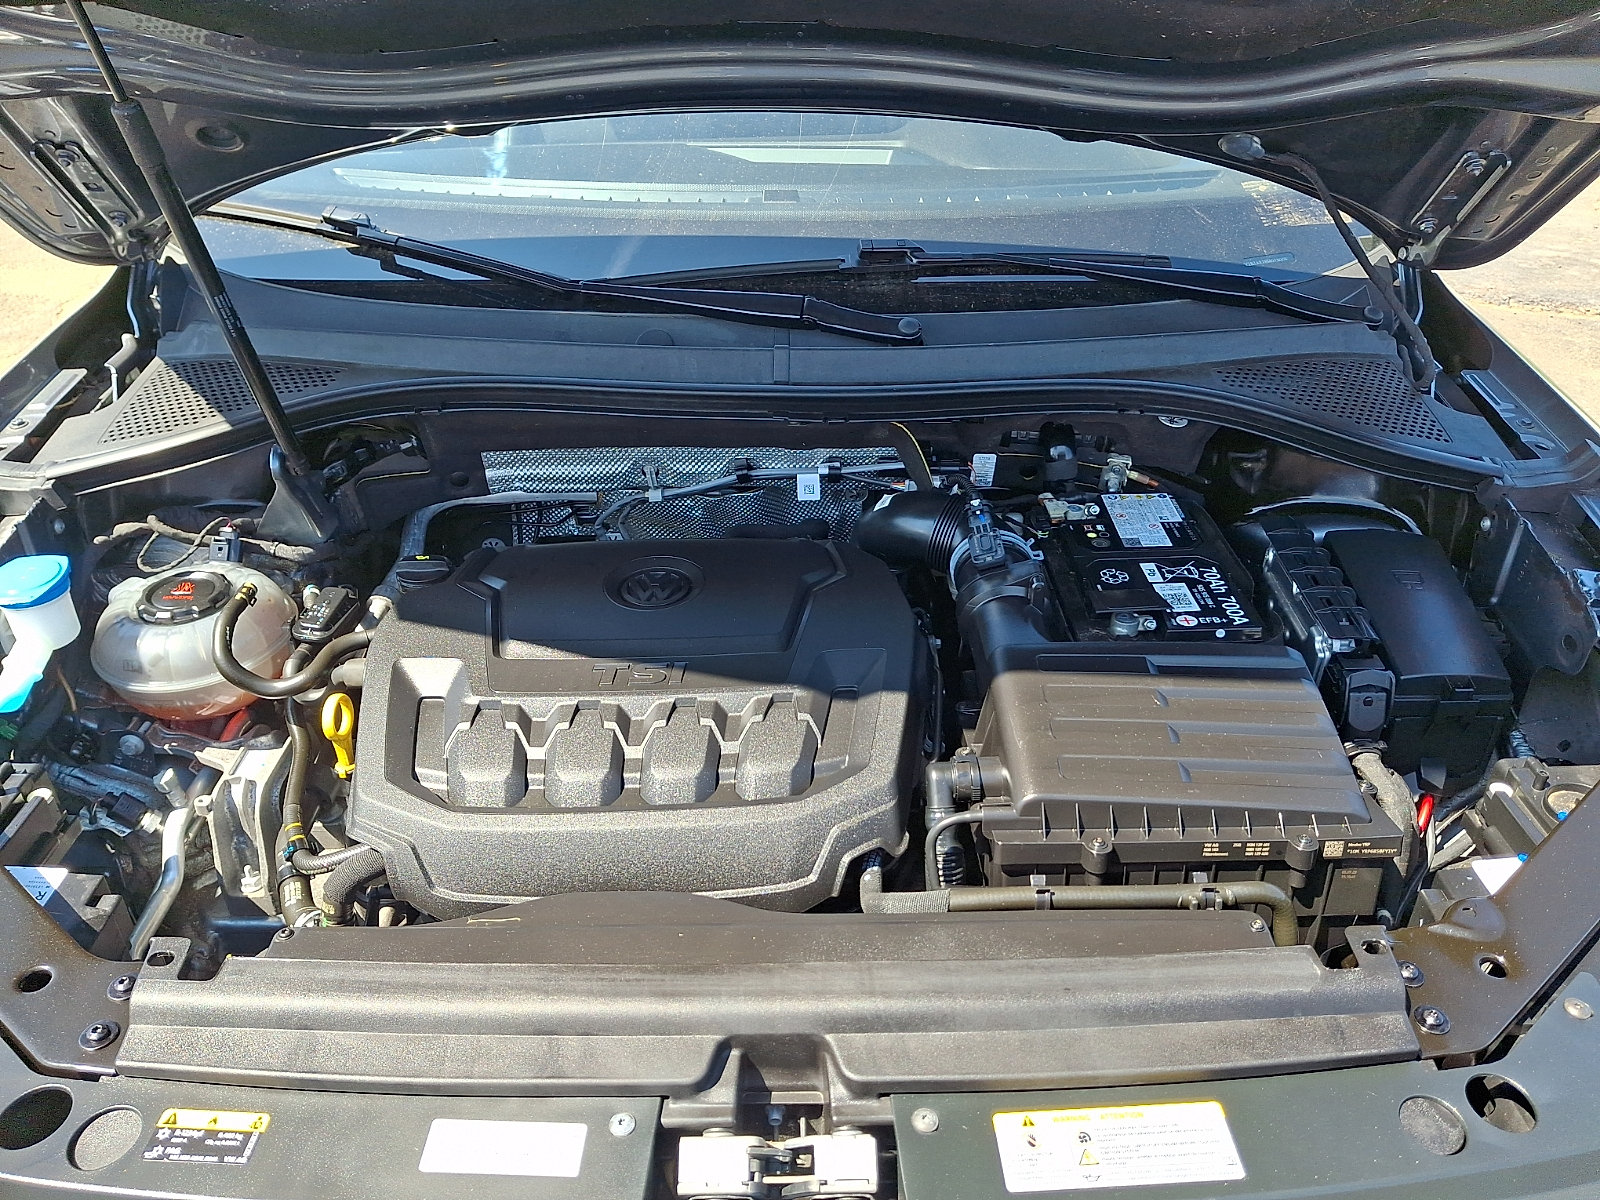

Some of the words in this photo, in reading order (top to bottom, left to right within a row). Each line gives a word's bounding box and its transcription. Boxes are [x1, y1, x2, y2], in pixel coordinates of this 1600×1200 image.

[1145, 568, 1156, 577] Pb
[1199, 567, 1228, 593] 70Ah
[1217, 595, 1250, 626] 700A
[1199, 616, 1229, 624] EFB+
[592, 662, 688, 686] TSI
[35, 891, 47, 901] R
[1053, 1115, 1092, 1124] WARNING
[1100, 1112, 1145, 1122] ATTENTION
